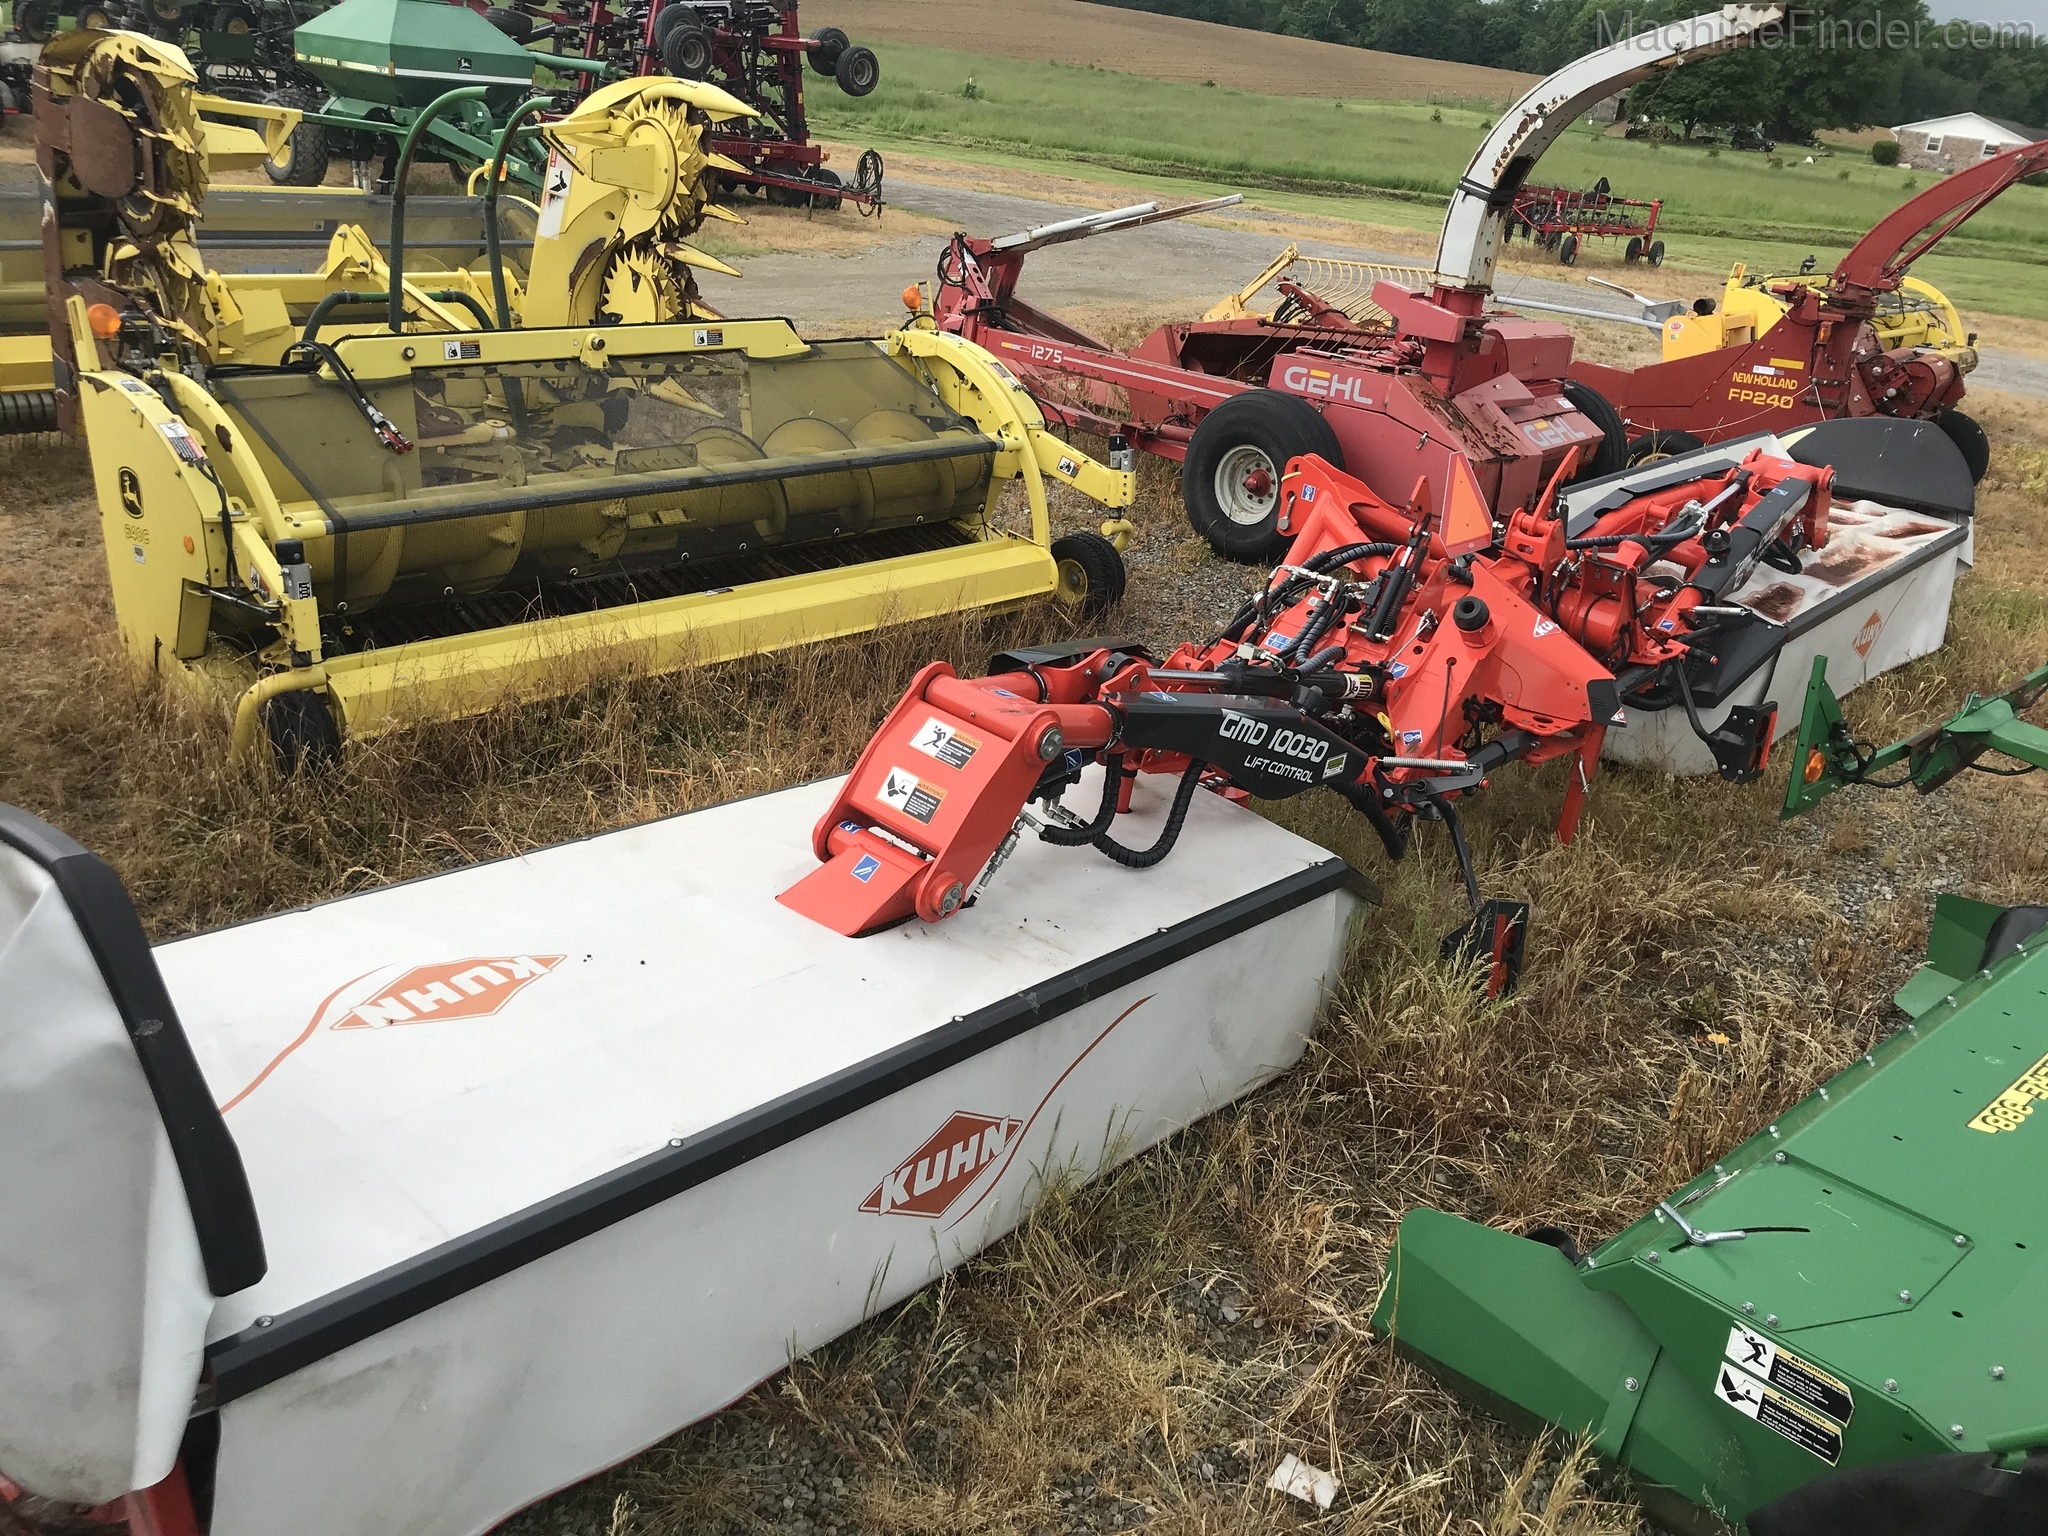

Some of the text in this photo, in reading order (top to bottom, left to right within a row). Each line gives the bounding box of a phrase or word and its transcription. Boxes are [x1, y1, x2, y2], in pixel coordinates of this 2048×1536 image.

[1031, 346, 1062, 363] 1275
[1284, 366, 1373, 405] GEHL
[1732, 372, 1798, 390] NEW HOLLAND
[1728, 388, 1794, 409] FP240
[1523, 416, 1586, 447] GEHL
[1218, 713, 1330, 763] GMD 10030
[1243, 754, 1271, 771] LIFT
[1268, 761, 1313, 784] CONTROL
[350, 954, 553, 1030] KUHN
[879, 1114, 1010, 1216] KUHN
